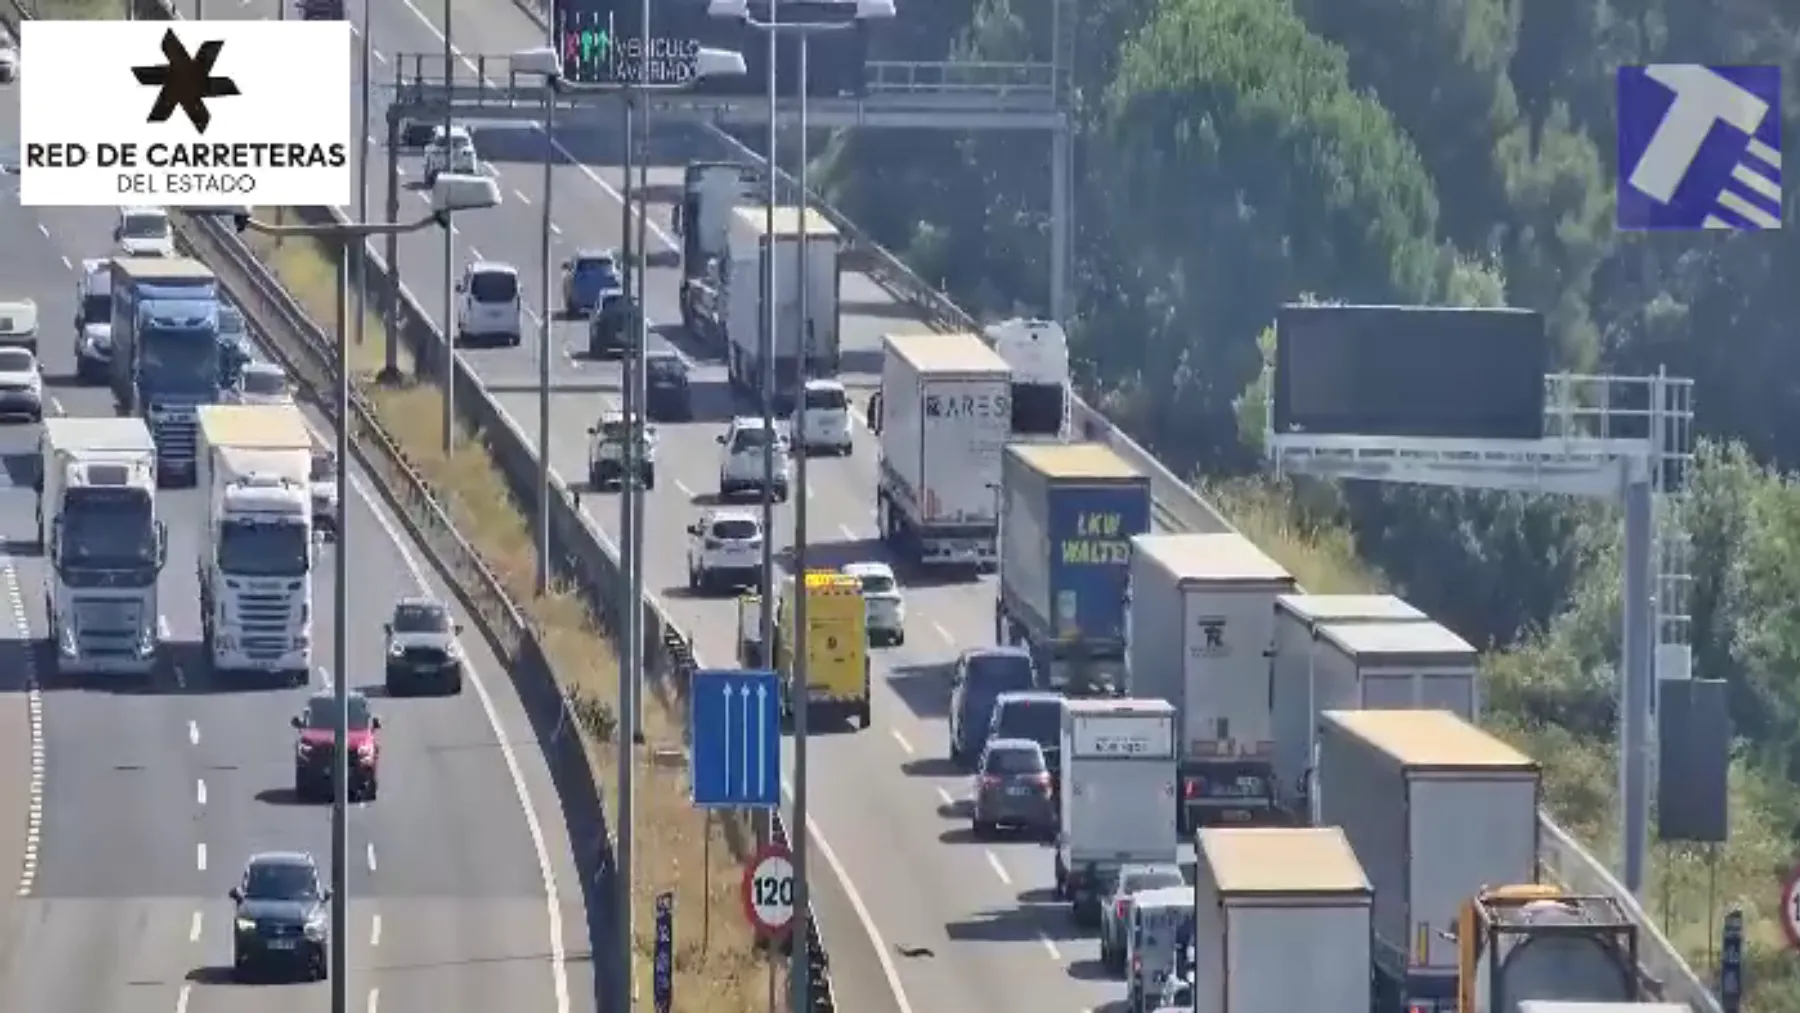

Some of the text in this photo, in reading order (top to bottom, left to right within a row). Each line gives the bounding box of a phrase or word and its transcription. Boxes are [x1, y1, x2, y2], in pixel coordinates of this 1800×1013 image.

[615, 37, 700, 57] VEICULO
[616, 60, 700, 80] AVRIADO
[1077, 511, 1120, 536] LKW
[754, 876, 795, 906] 120
